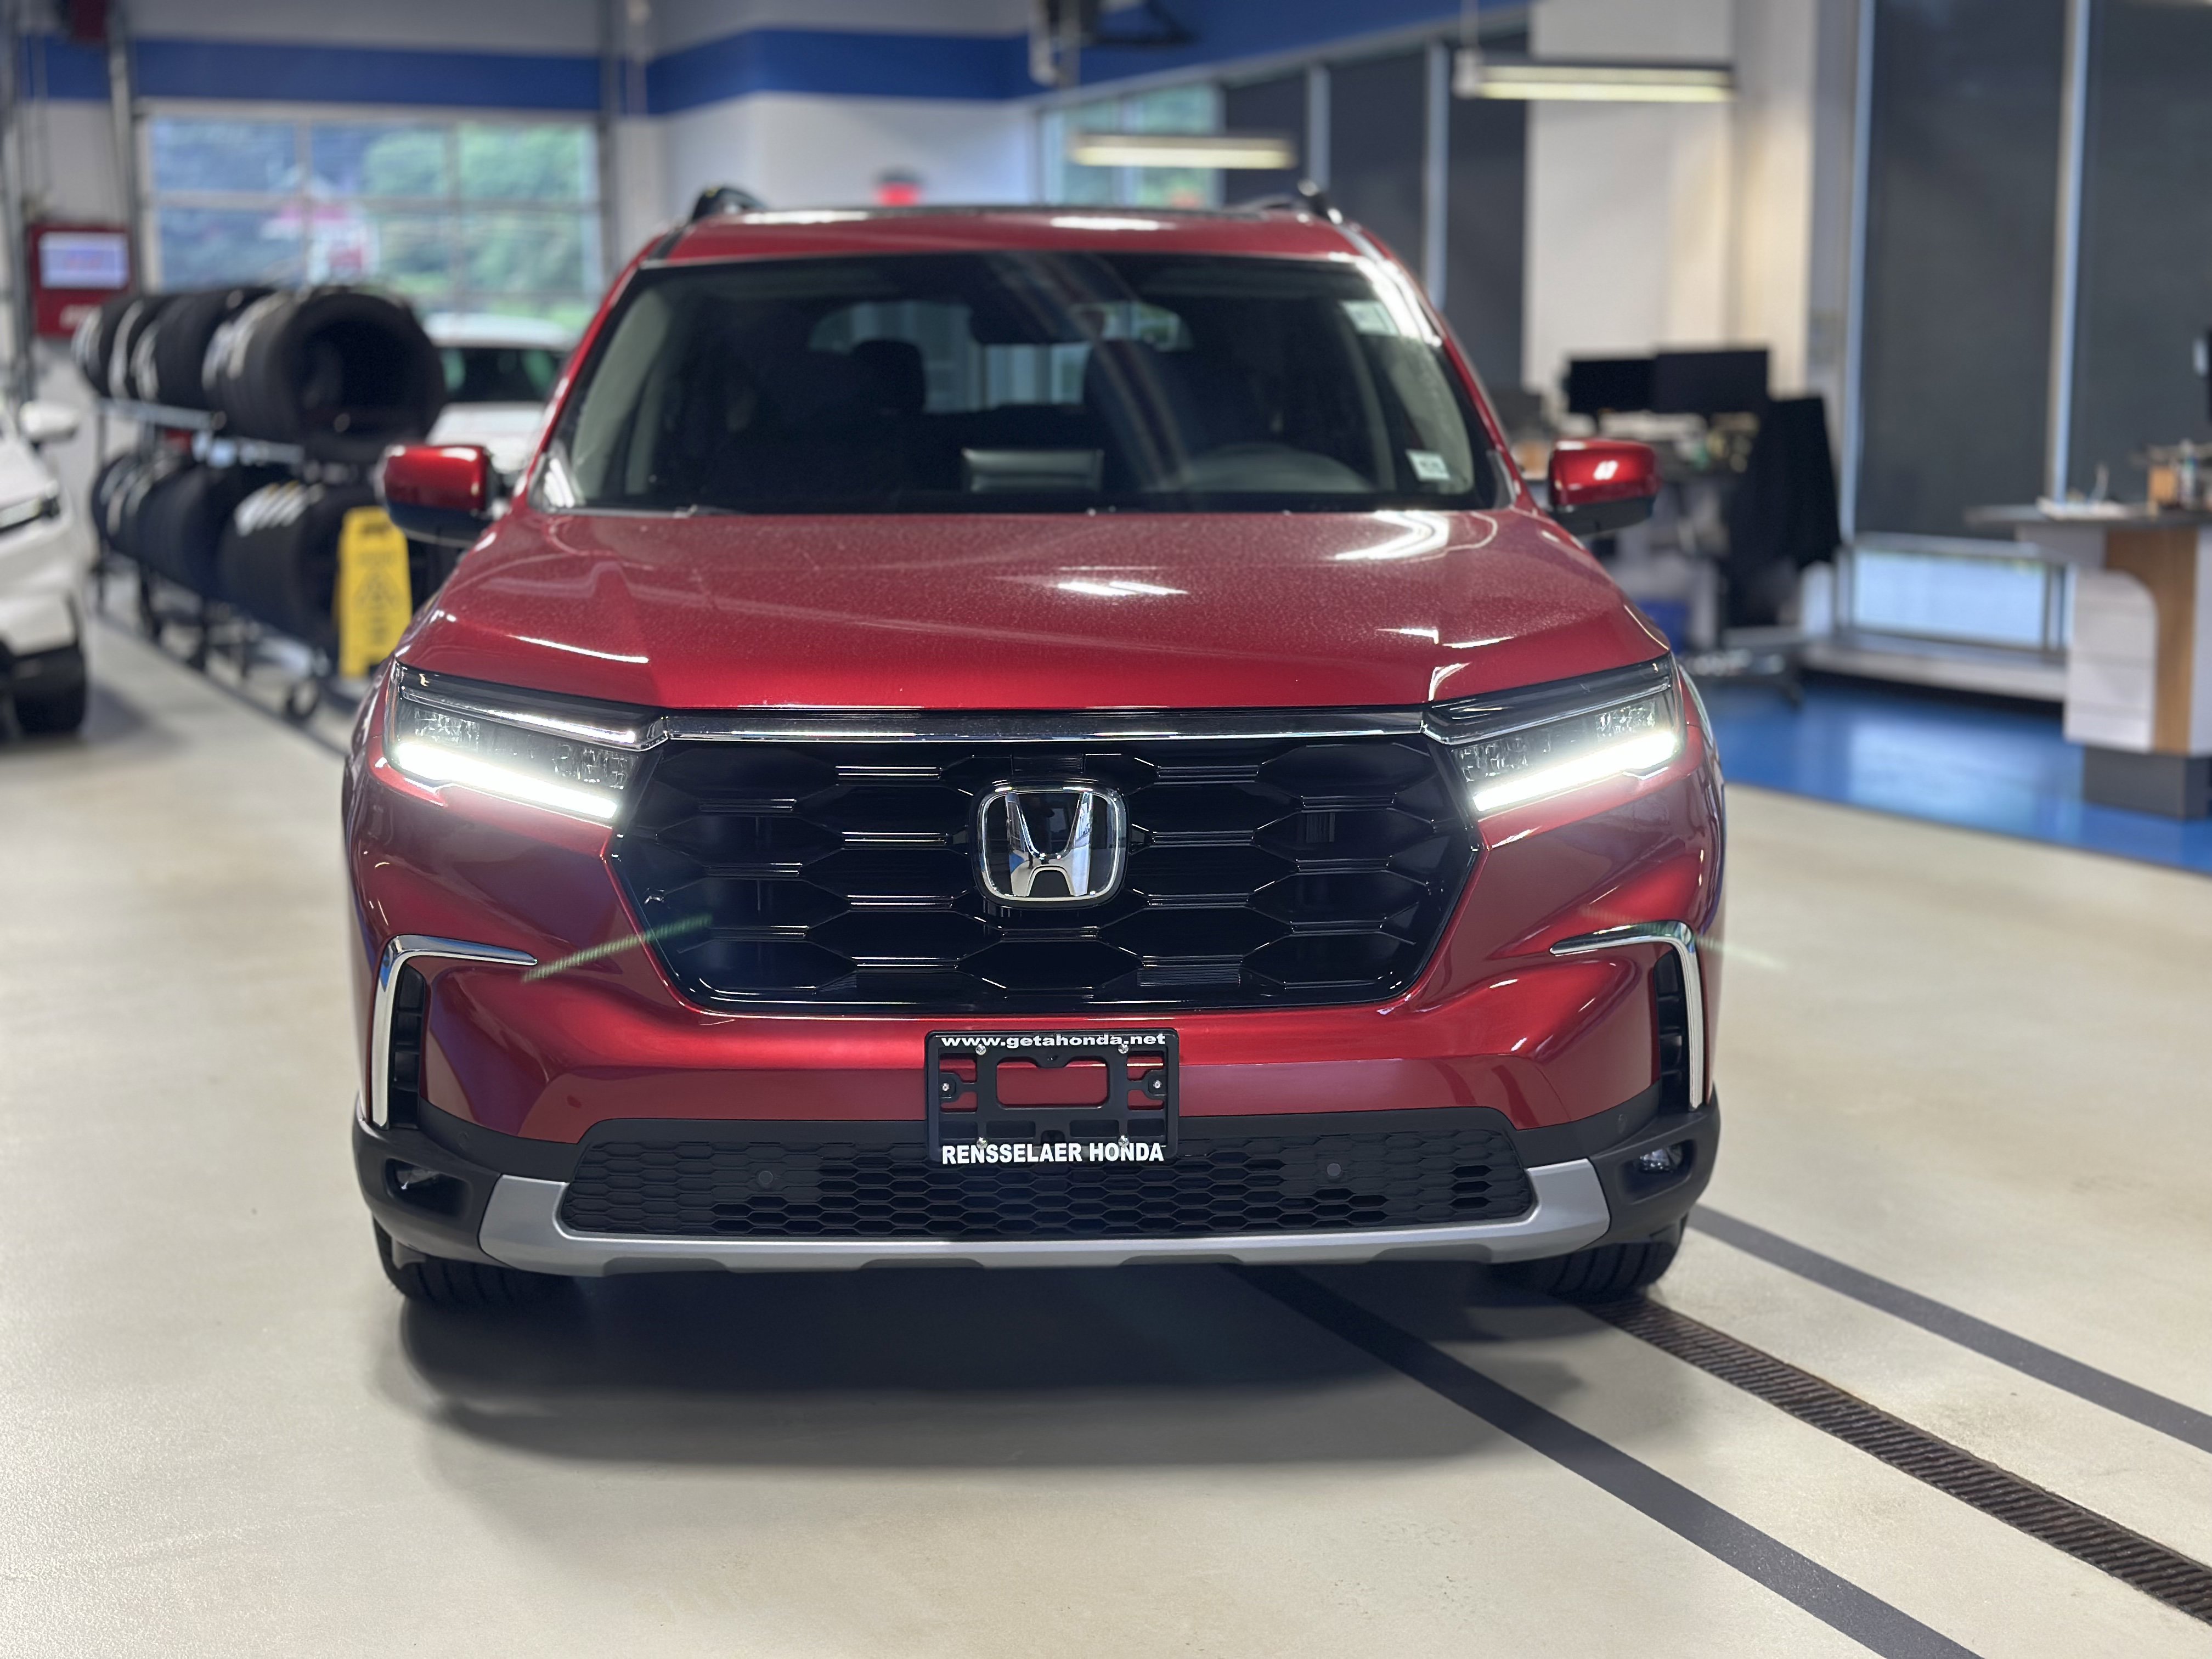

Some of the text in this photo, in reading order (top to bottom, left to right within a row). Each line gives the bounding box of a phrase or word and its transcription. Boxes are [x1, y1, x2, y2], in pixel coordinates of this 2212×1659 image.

[941, 1033, 1166, 1049] www.getahonda.net
[942, 1143, 1164, 1164] RENSSELAER HONDA
